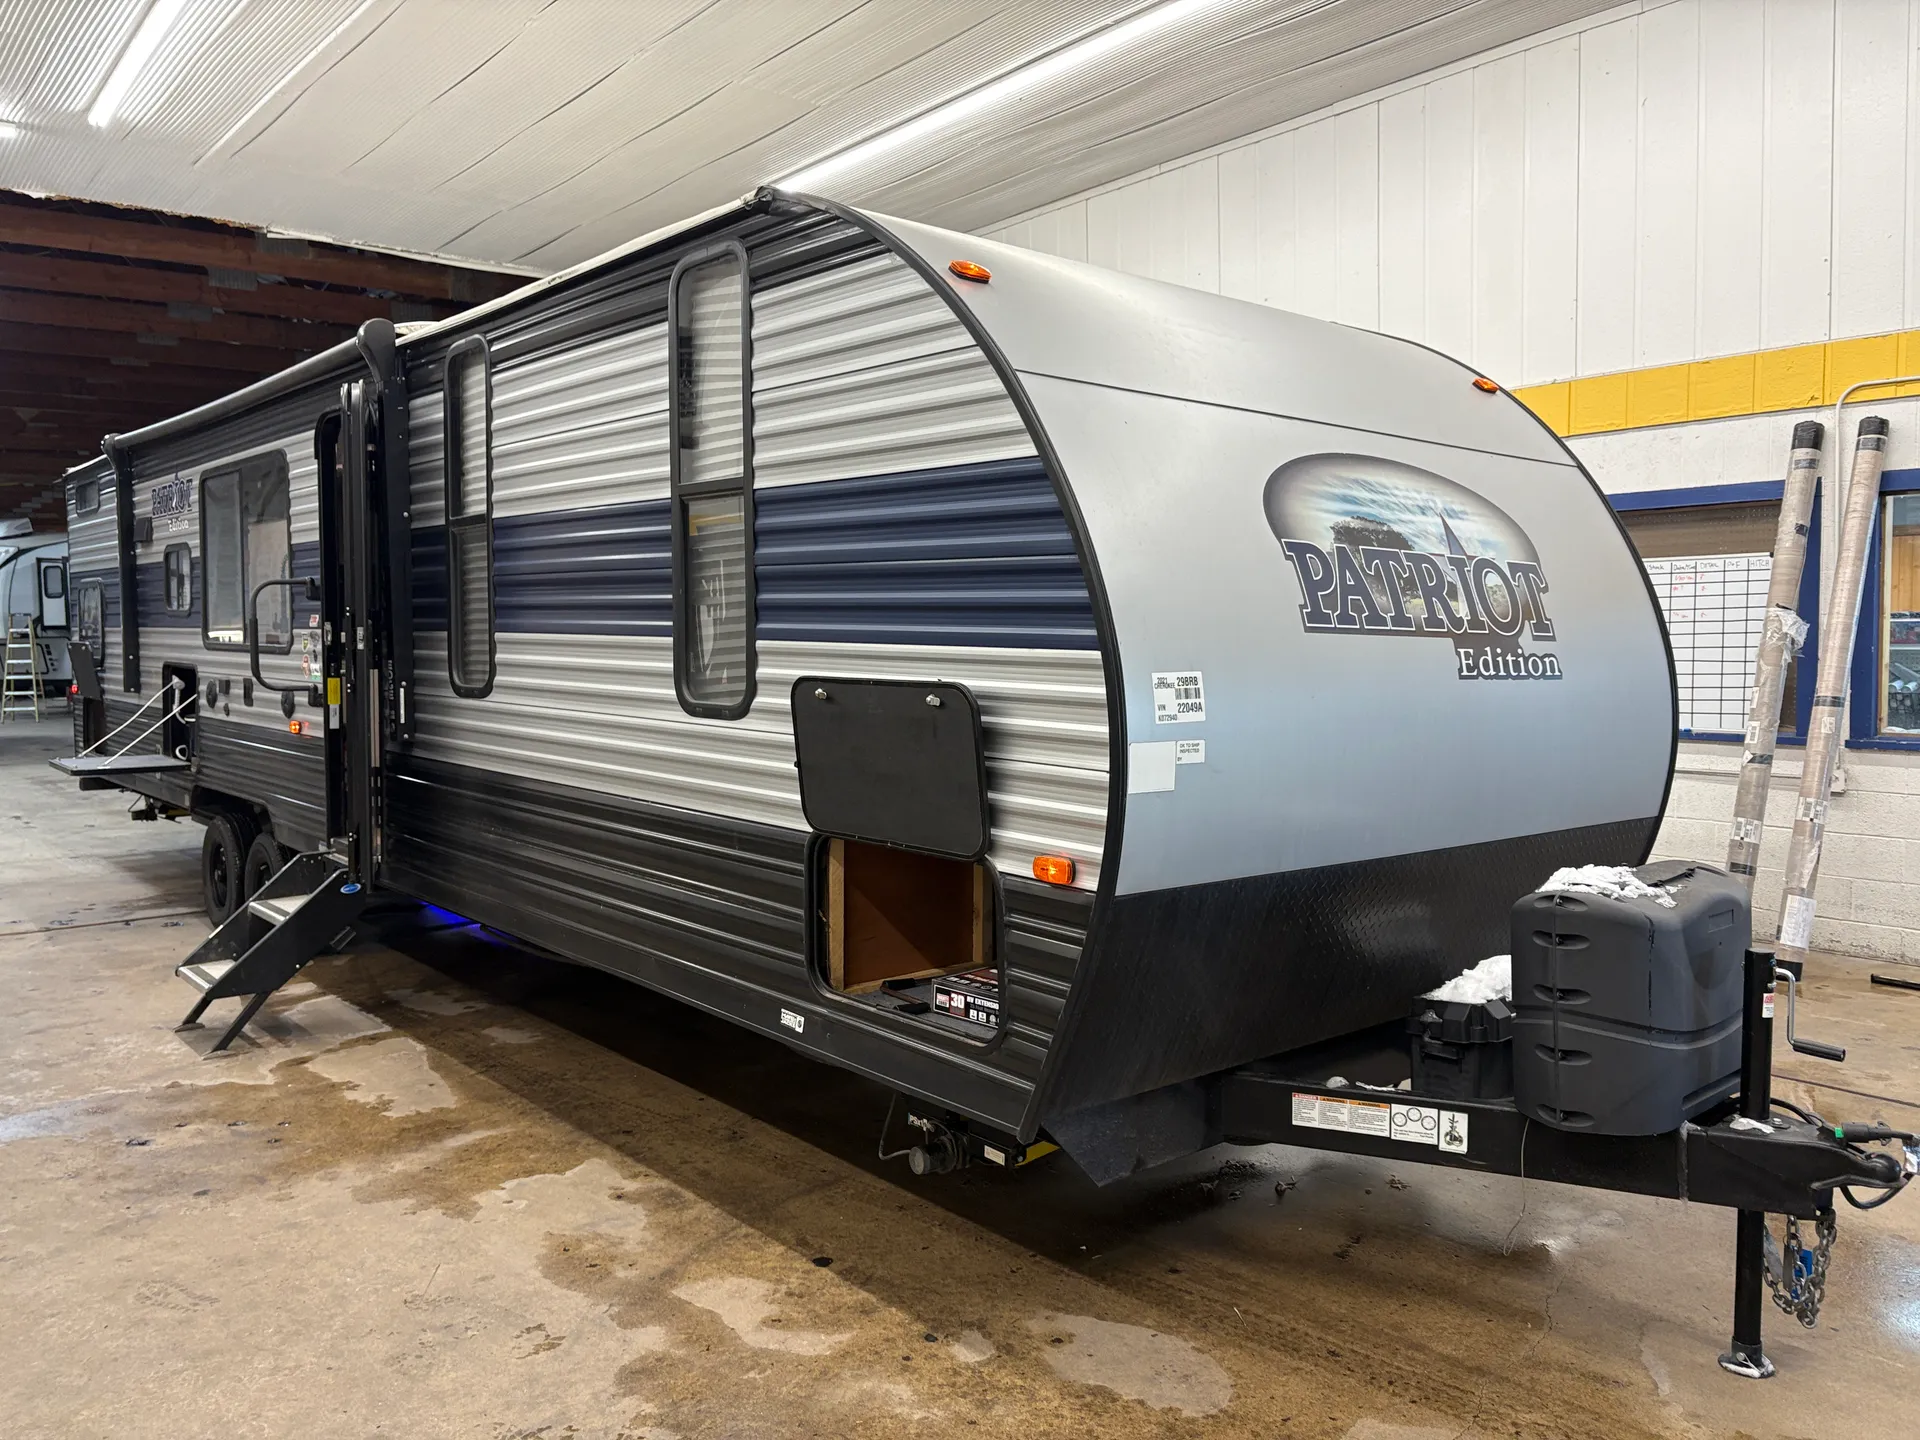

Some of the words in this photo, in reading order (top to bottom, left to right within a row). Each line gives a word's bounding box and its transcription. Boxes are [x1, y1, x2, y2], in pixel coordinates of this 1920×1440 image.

[151, 477, 194, 517] PATRIOT
[168, 517, 190, 532] Edition
[1281, 538, 1555, 636] PATRIOT
[1456, 646, 1562, 678] Edition
[1177, 676, 1199, 687] 29BRB
[1177, 702, 1203, 713] 22049A
[950, 991, 965, 1009] 30
[974, 997, 999, 1011] EXTENSIO
